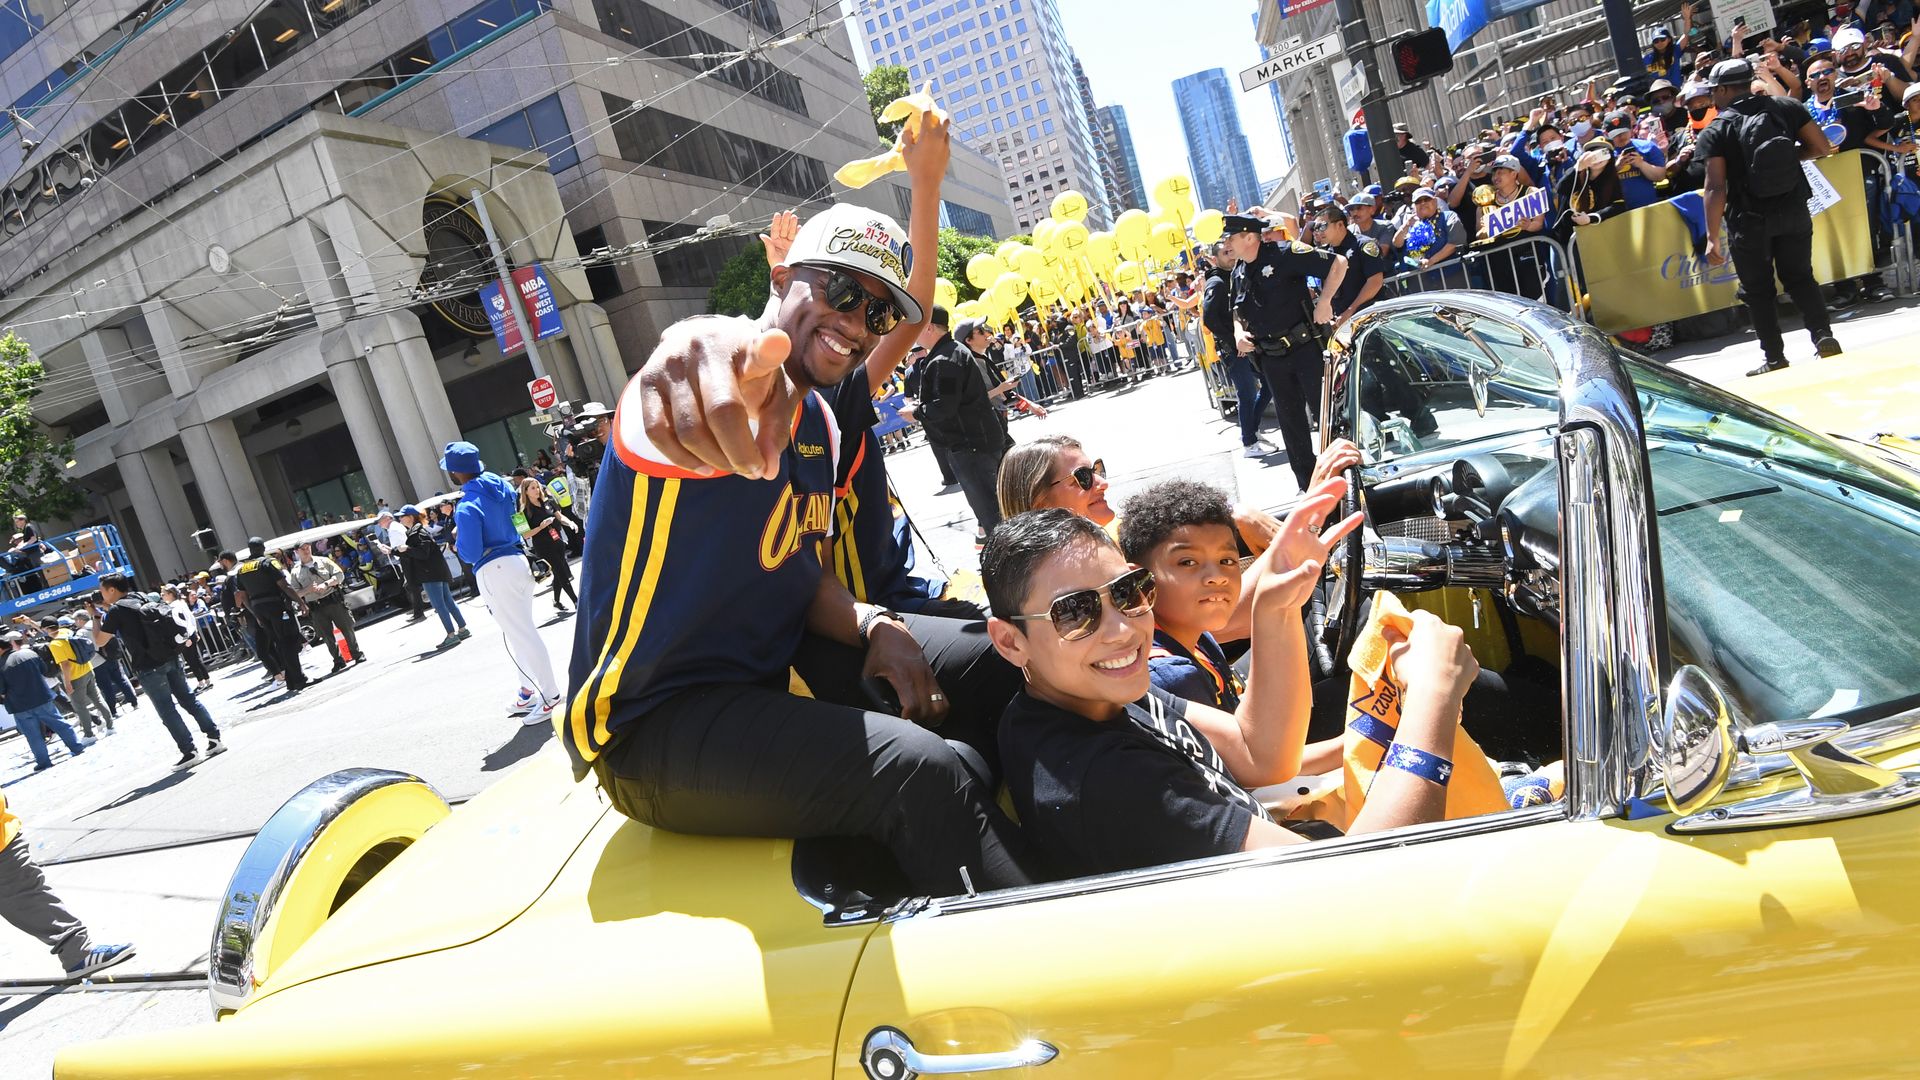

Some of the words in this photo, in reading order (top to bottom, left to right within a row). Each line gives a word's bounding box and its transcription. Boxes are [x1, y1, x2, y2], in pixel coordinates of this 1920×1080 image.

[1272, 41, 1290, 54] 200
[1256, 42, 1325, 81] MARKET
[1810, 174, 1824, 191] from
[1822, 188, 1832, 200] the
[1488, 189, 1548, 237] AGAIN!
[867, 219, 885, 231] The
[864, 227, 890, 247] 21-22
[888, 237, 902, 259] NBA
[520, 276, 546, 294] MBA
[534, 297, 552, 310] WEST
[534, 304, 554, 318] COAST
[490, 308, 514, 322] Wharto
[540, 382, 549, 390] NOT
[538, 395, 552, 405] ENTER
[15, 597, 36, 608] Genie
[38, 585, 72, 600] GS-2646
[1371, 686, 1397, 716] 2022
